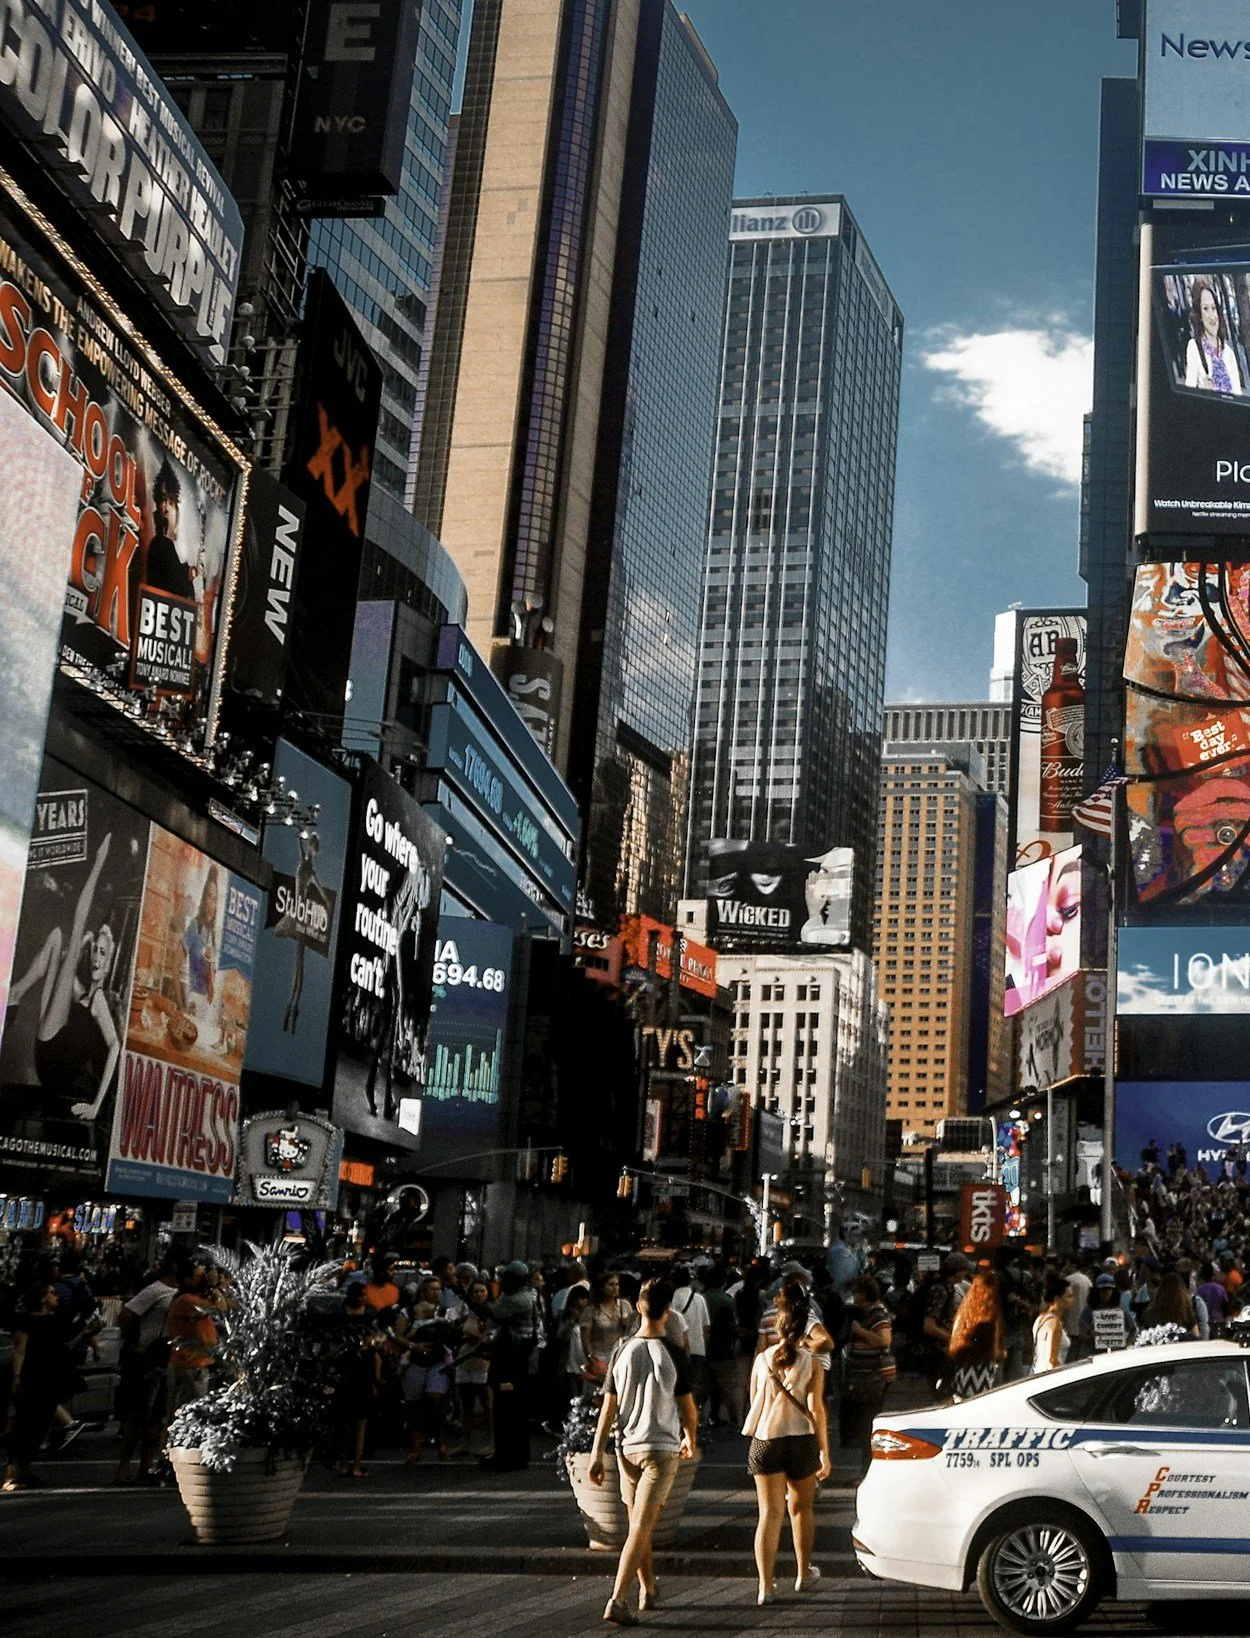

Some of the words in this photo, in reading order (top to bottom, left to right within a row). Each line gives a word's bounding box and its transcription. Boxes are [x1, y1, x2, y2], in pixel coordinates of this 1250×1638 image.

[314, 116, 367, 134] NYC
[1161, 173, 1228, 190] NEWS
[732, 214, 787, 232] lianz
[119, 150, 232, 366] PURPLE
[53, 295, 76, 342] THE
[1154, 500, 1181, 508] Watch
[1181, 500, 1233, 510] Unbreakable
[69, 500, 139, 650] CK
[264, 504, 300, 645] NEW
[138, 597, 195, 647] BEST
[137, 635, 193, 671] MUSICAL!
[1200, 732, 1225, 750] day
[36, 801, 86, 831] YEARS
[365, 798, 384, 844] Go
[360, 852, 390, 899] your
[228, 886, 260, 926] BEST
[119, 1053, 239, 1177] WAITRESS
[259, 1181, 308, 1198] Sanrio
[971, 1189, 998, 1244] tkts
[943, 1427, 1076, 1450] TRAFFIC
[946, 1453, 974, 1468] 7759
[989, 1453, 1012, 1468] SPL
[1017, 1452, 1040, 1468] OPS
[1155, 1466, 1216, 1483] COURTESY
[1145, 1482, 1249, 1500] PROFESSIONALISM
[1133, 1498, 1190, 1515] RESPECT
